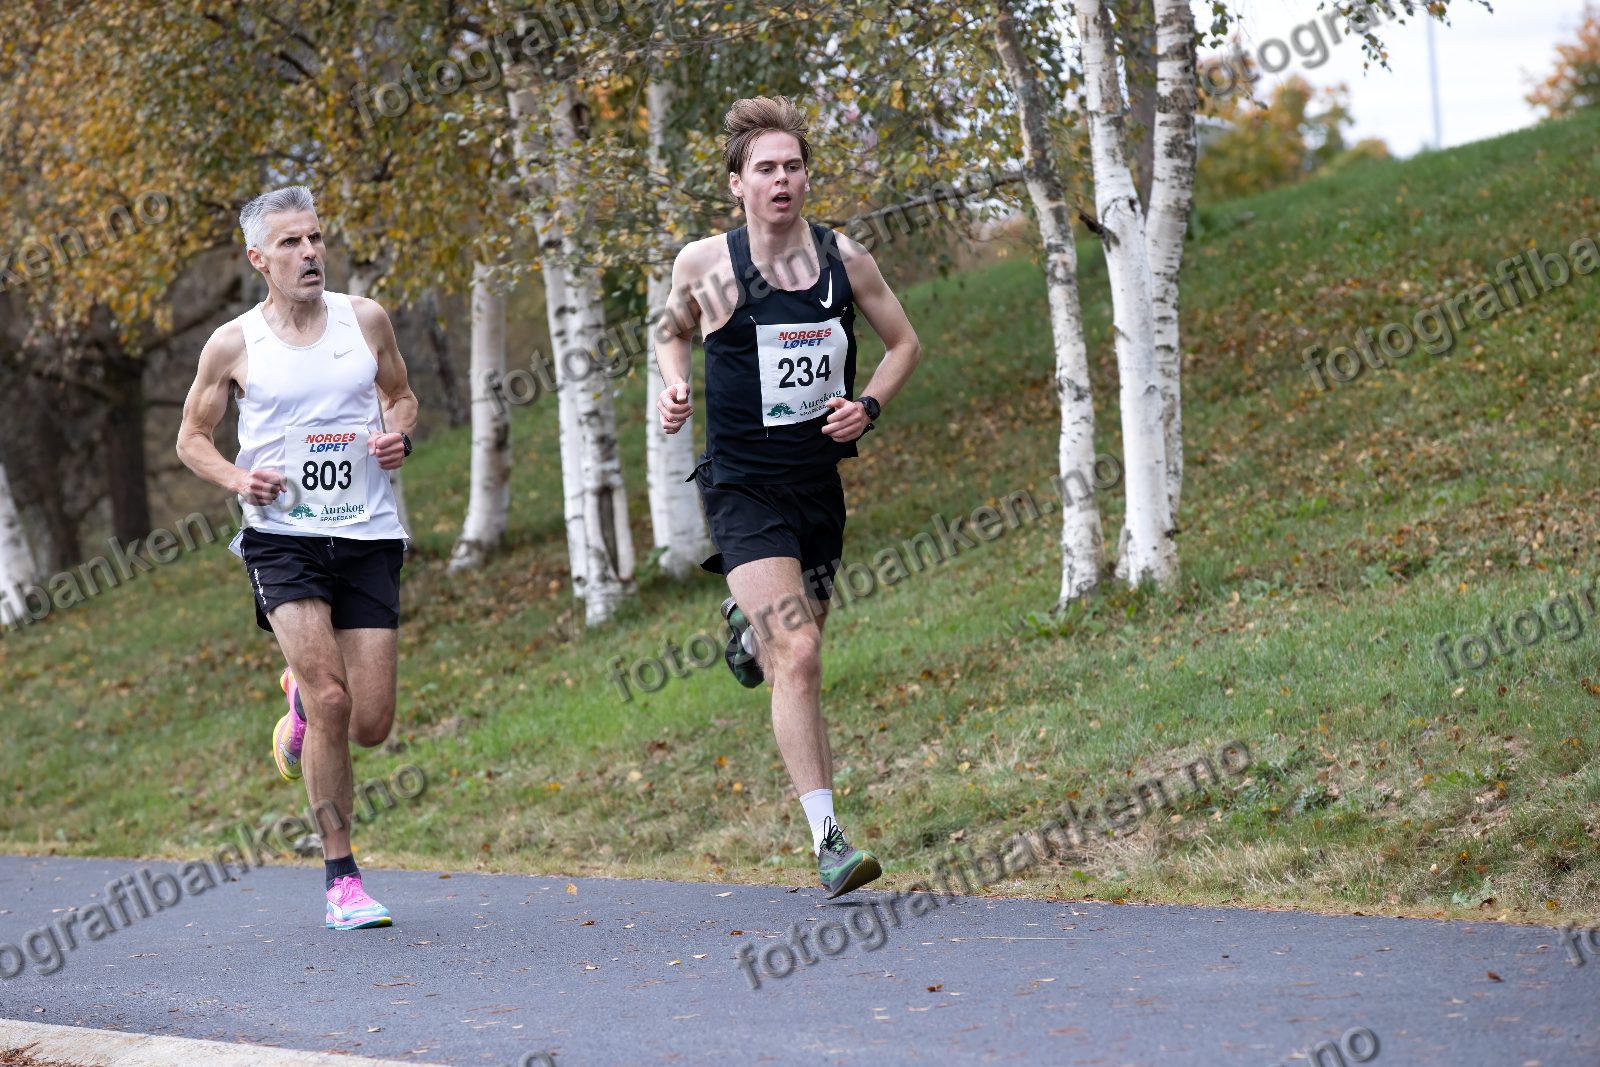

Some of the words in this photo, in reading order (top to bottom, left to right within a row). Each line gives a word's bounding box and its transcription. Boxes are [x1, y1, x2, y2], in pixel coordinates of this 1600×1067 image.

[779, 328, 831, 340] NORGES
[783, 338, 824, 349] LØPET
[777, 354, 832, 389] 234
[305, 433, 356, 443] NORGES
[309, 443, 348, 453] LØPET
[301, 460, 352, 491] 803
[321, 503, 364, 514] Aurskog
